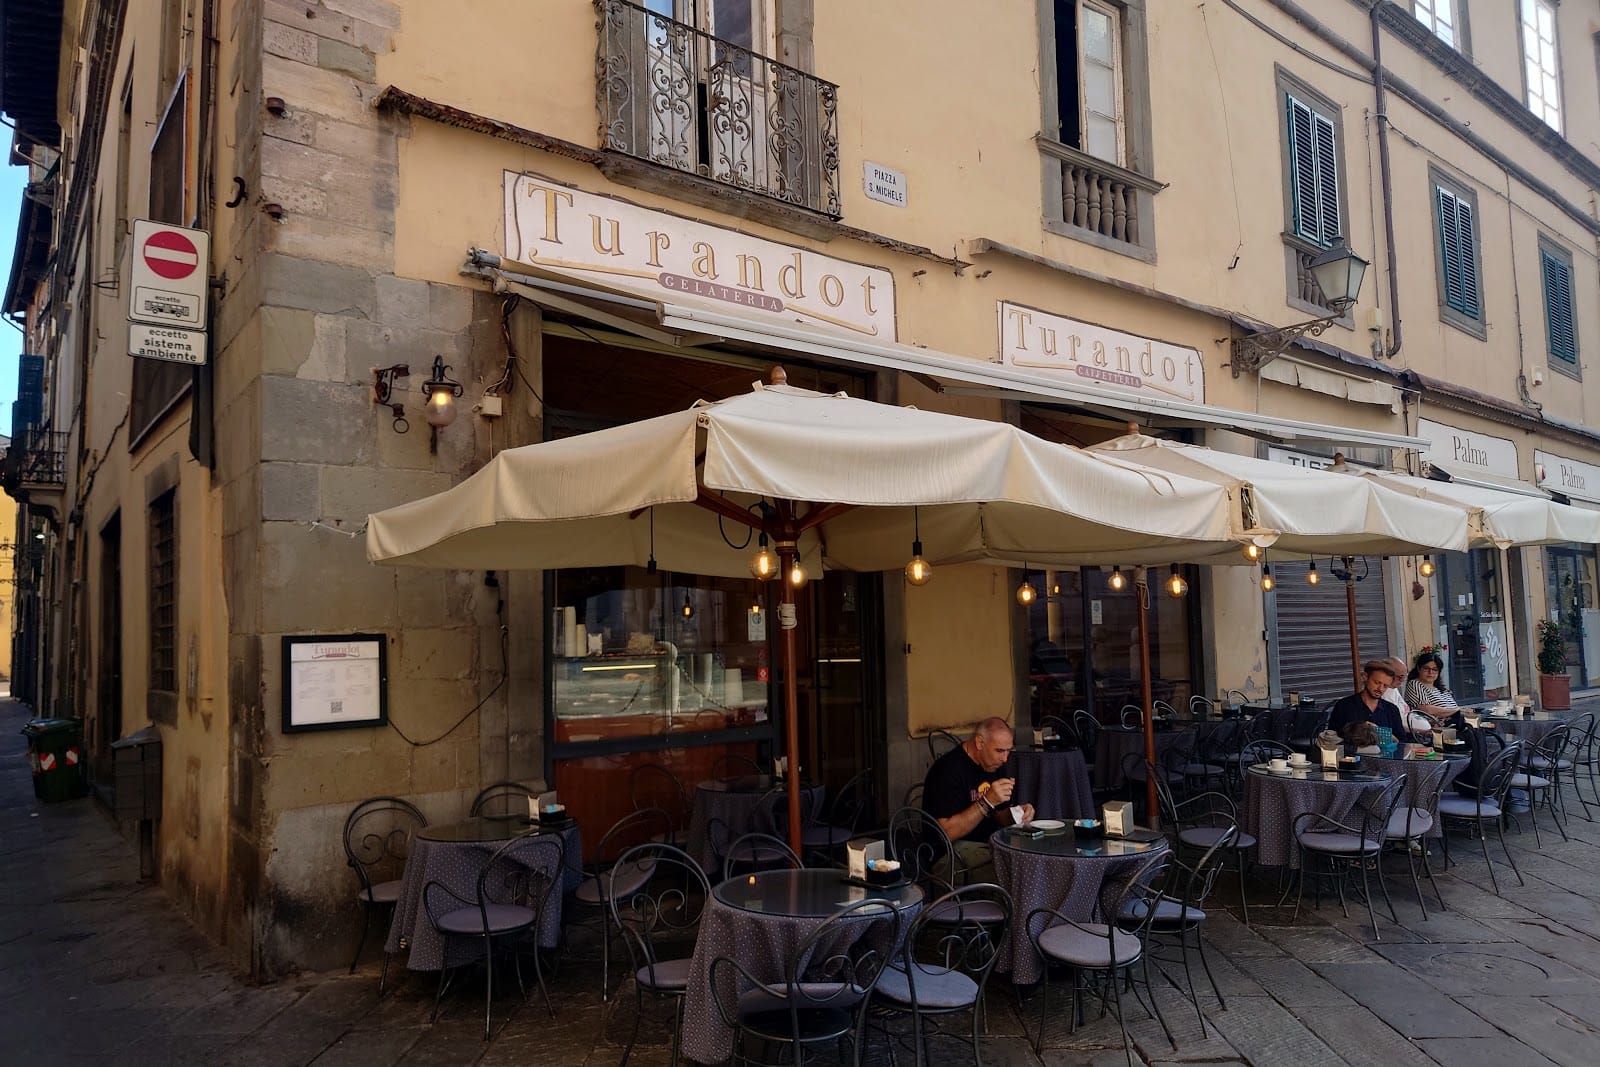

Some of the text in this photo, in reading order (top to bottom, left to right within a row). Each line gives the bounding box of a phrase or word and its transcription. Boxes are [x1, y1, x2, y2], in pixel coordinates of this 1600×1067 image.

[874, 169, 897, 186] PIAZZA
[527, 183, 878, 316] Turandot
[154, 295, 182, 303] eccetto
[665, 276, 778, 310] GELATERIA
[144, 337, 193, 352] sistema
[149, 328, 188, 340] eccetto
[1008, 308, 1195, 386] Turandot
[138, 347, 197, 362] ambiente
[1452, 435, 1489, 467] Palma
[1560, 464, 1586, 491] Palma
[1486, 625, 1505, 673] 50%
